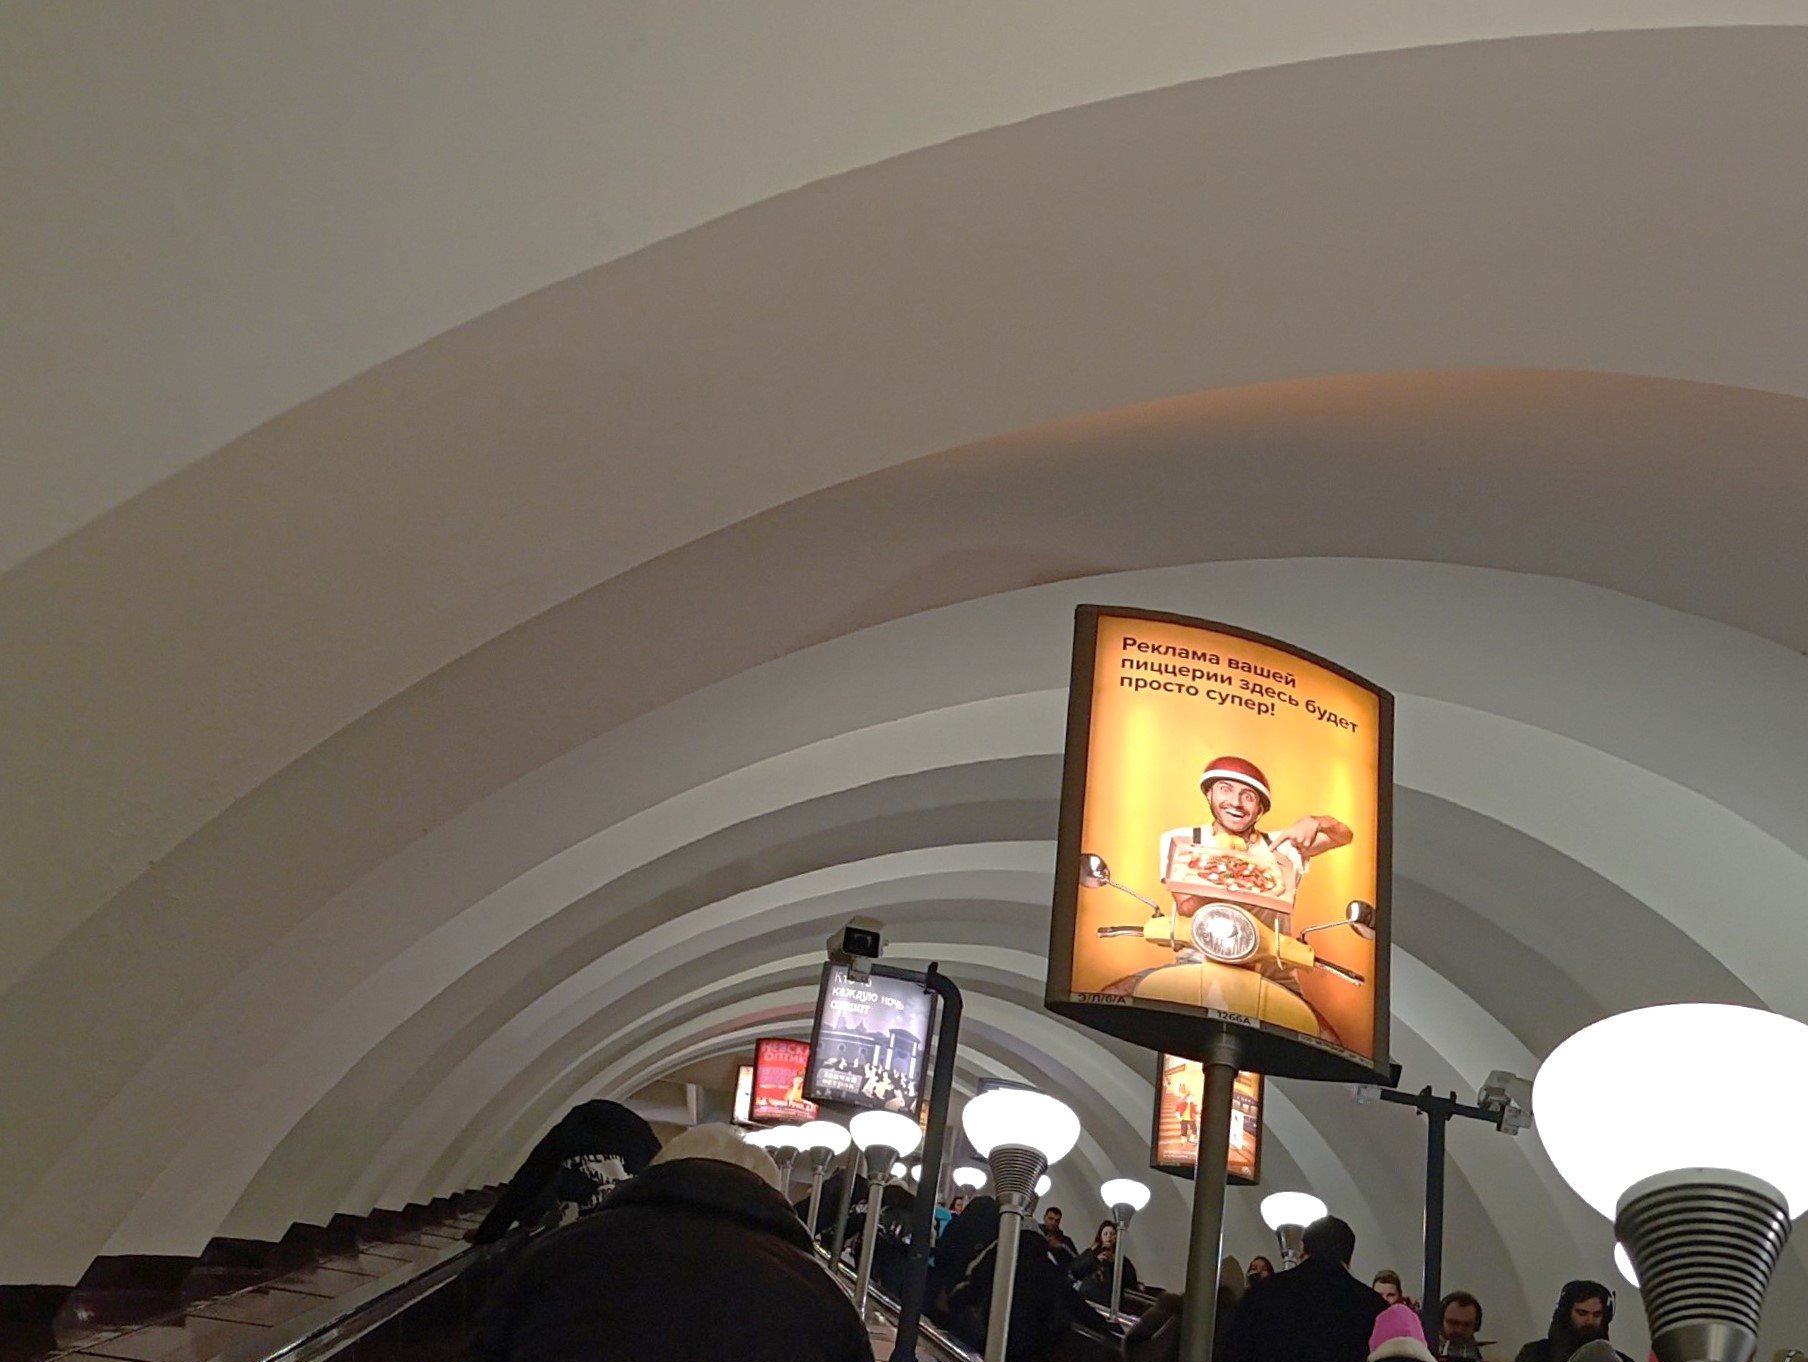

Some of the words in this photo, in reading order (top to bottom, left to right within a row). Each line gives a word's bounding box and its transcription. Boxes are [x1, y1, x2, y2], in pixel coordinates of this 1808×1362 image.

[1122, 636, 1220, 665] Реклама
[1227, 658, 1297, 689] вашей
[1120, 676, 1199, 697] просто
[1205, 689, 1276, 717] супер!
[1121, 658, 1232, 686] пиццерии
[1239, 678, 1299, 707] здесь
[1304, 699, 1358, 733] будет
